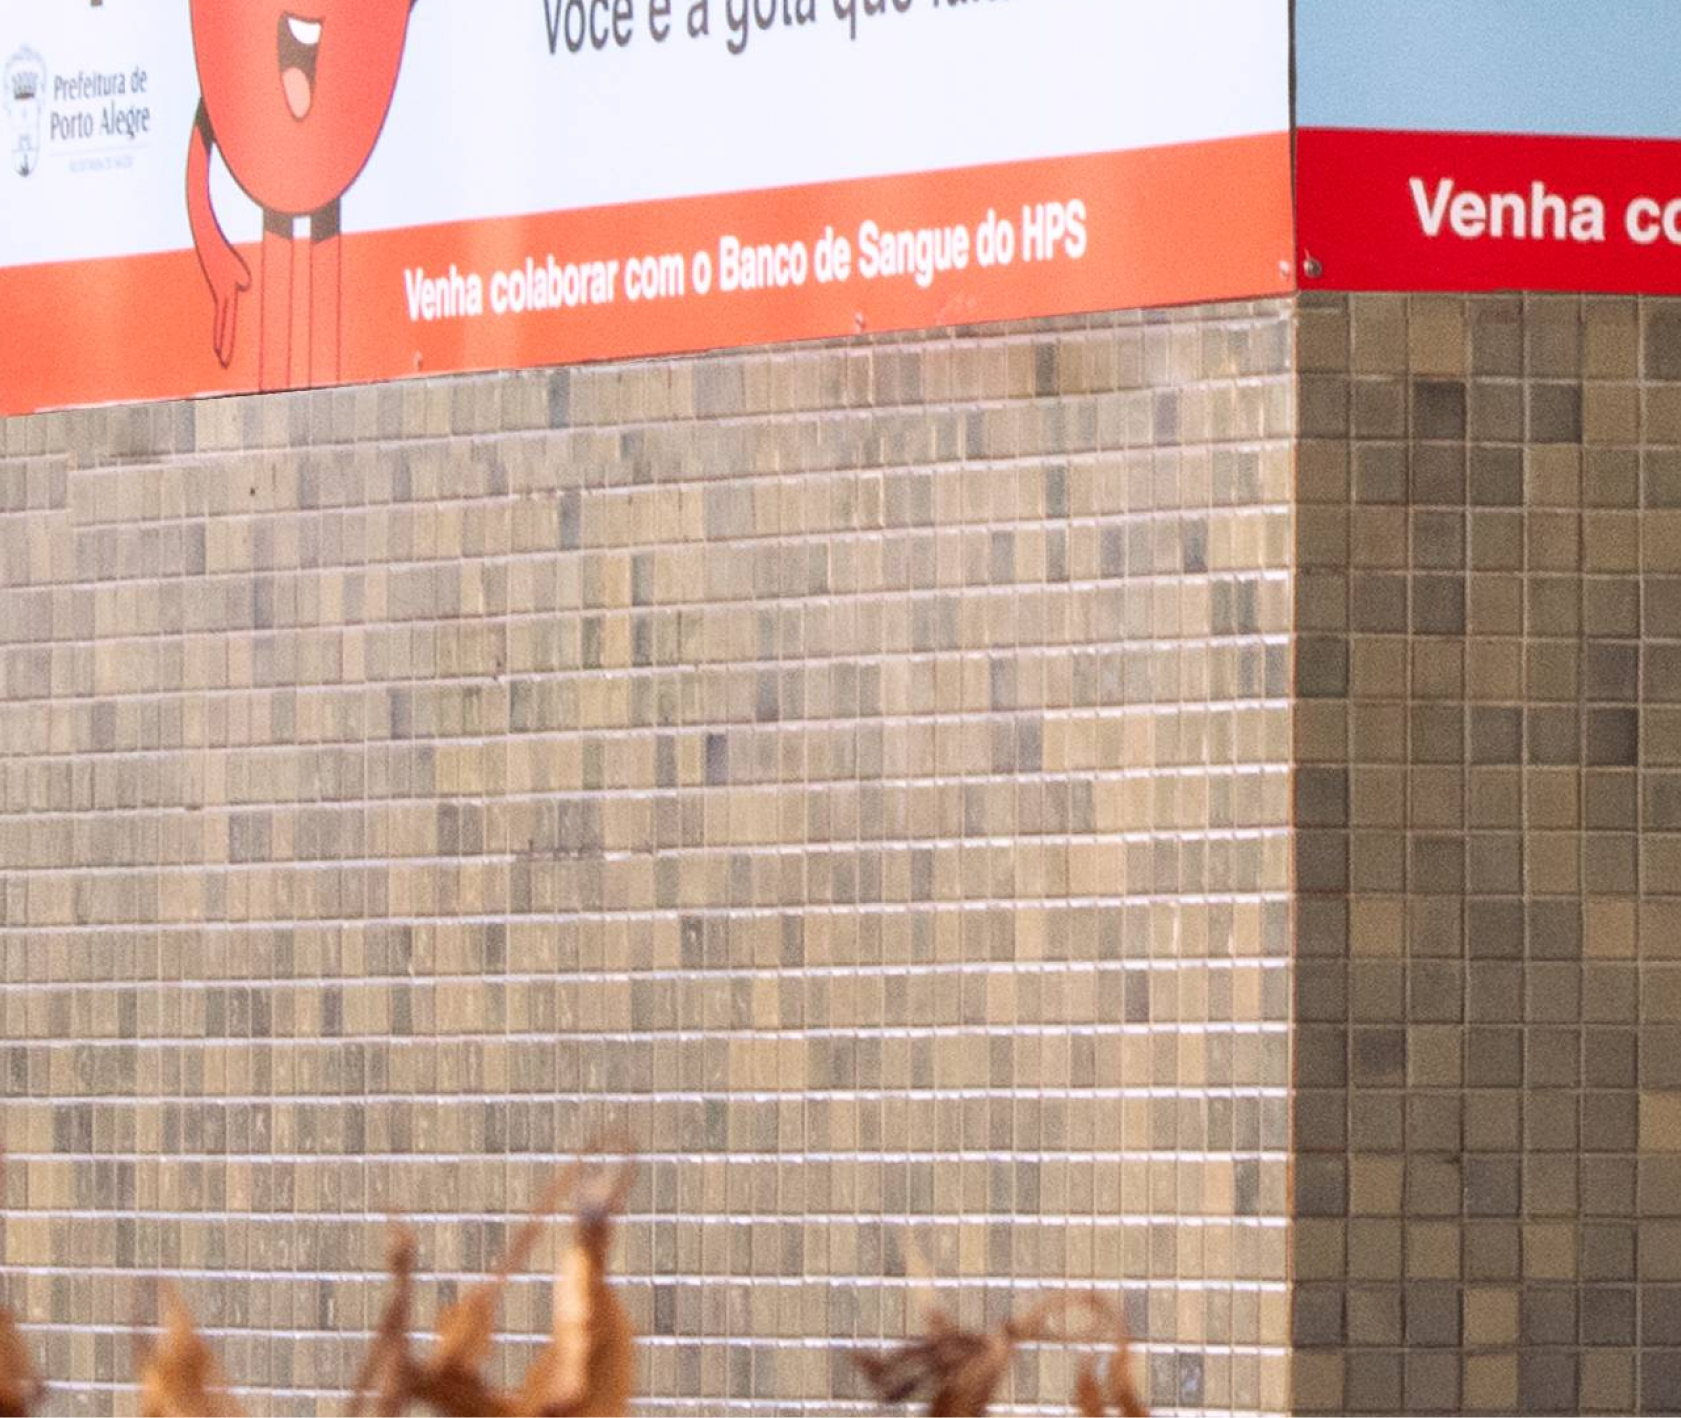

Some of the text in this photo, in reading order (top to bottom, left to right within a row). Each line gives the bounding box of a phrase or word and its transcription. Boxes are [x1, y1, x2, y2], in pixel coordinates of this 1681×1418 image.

[53, 65, 148, 102] Prefeitura de
[49, 100, 151, 141] Porto Alegre
[1408, 177, 1605, 242] Venha
[404, 198, 1088, 321] Venha colaborar com o Banco de Sangue do HPS
